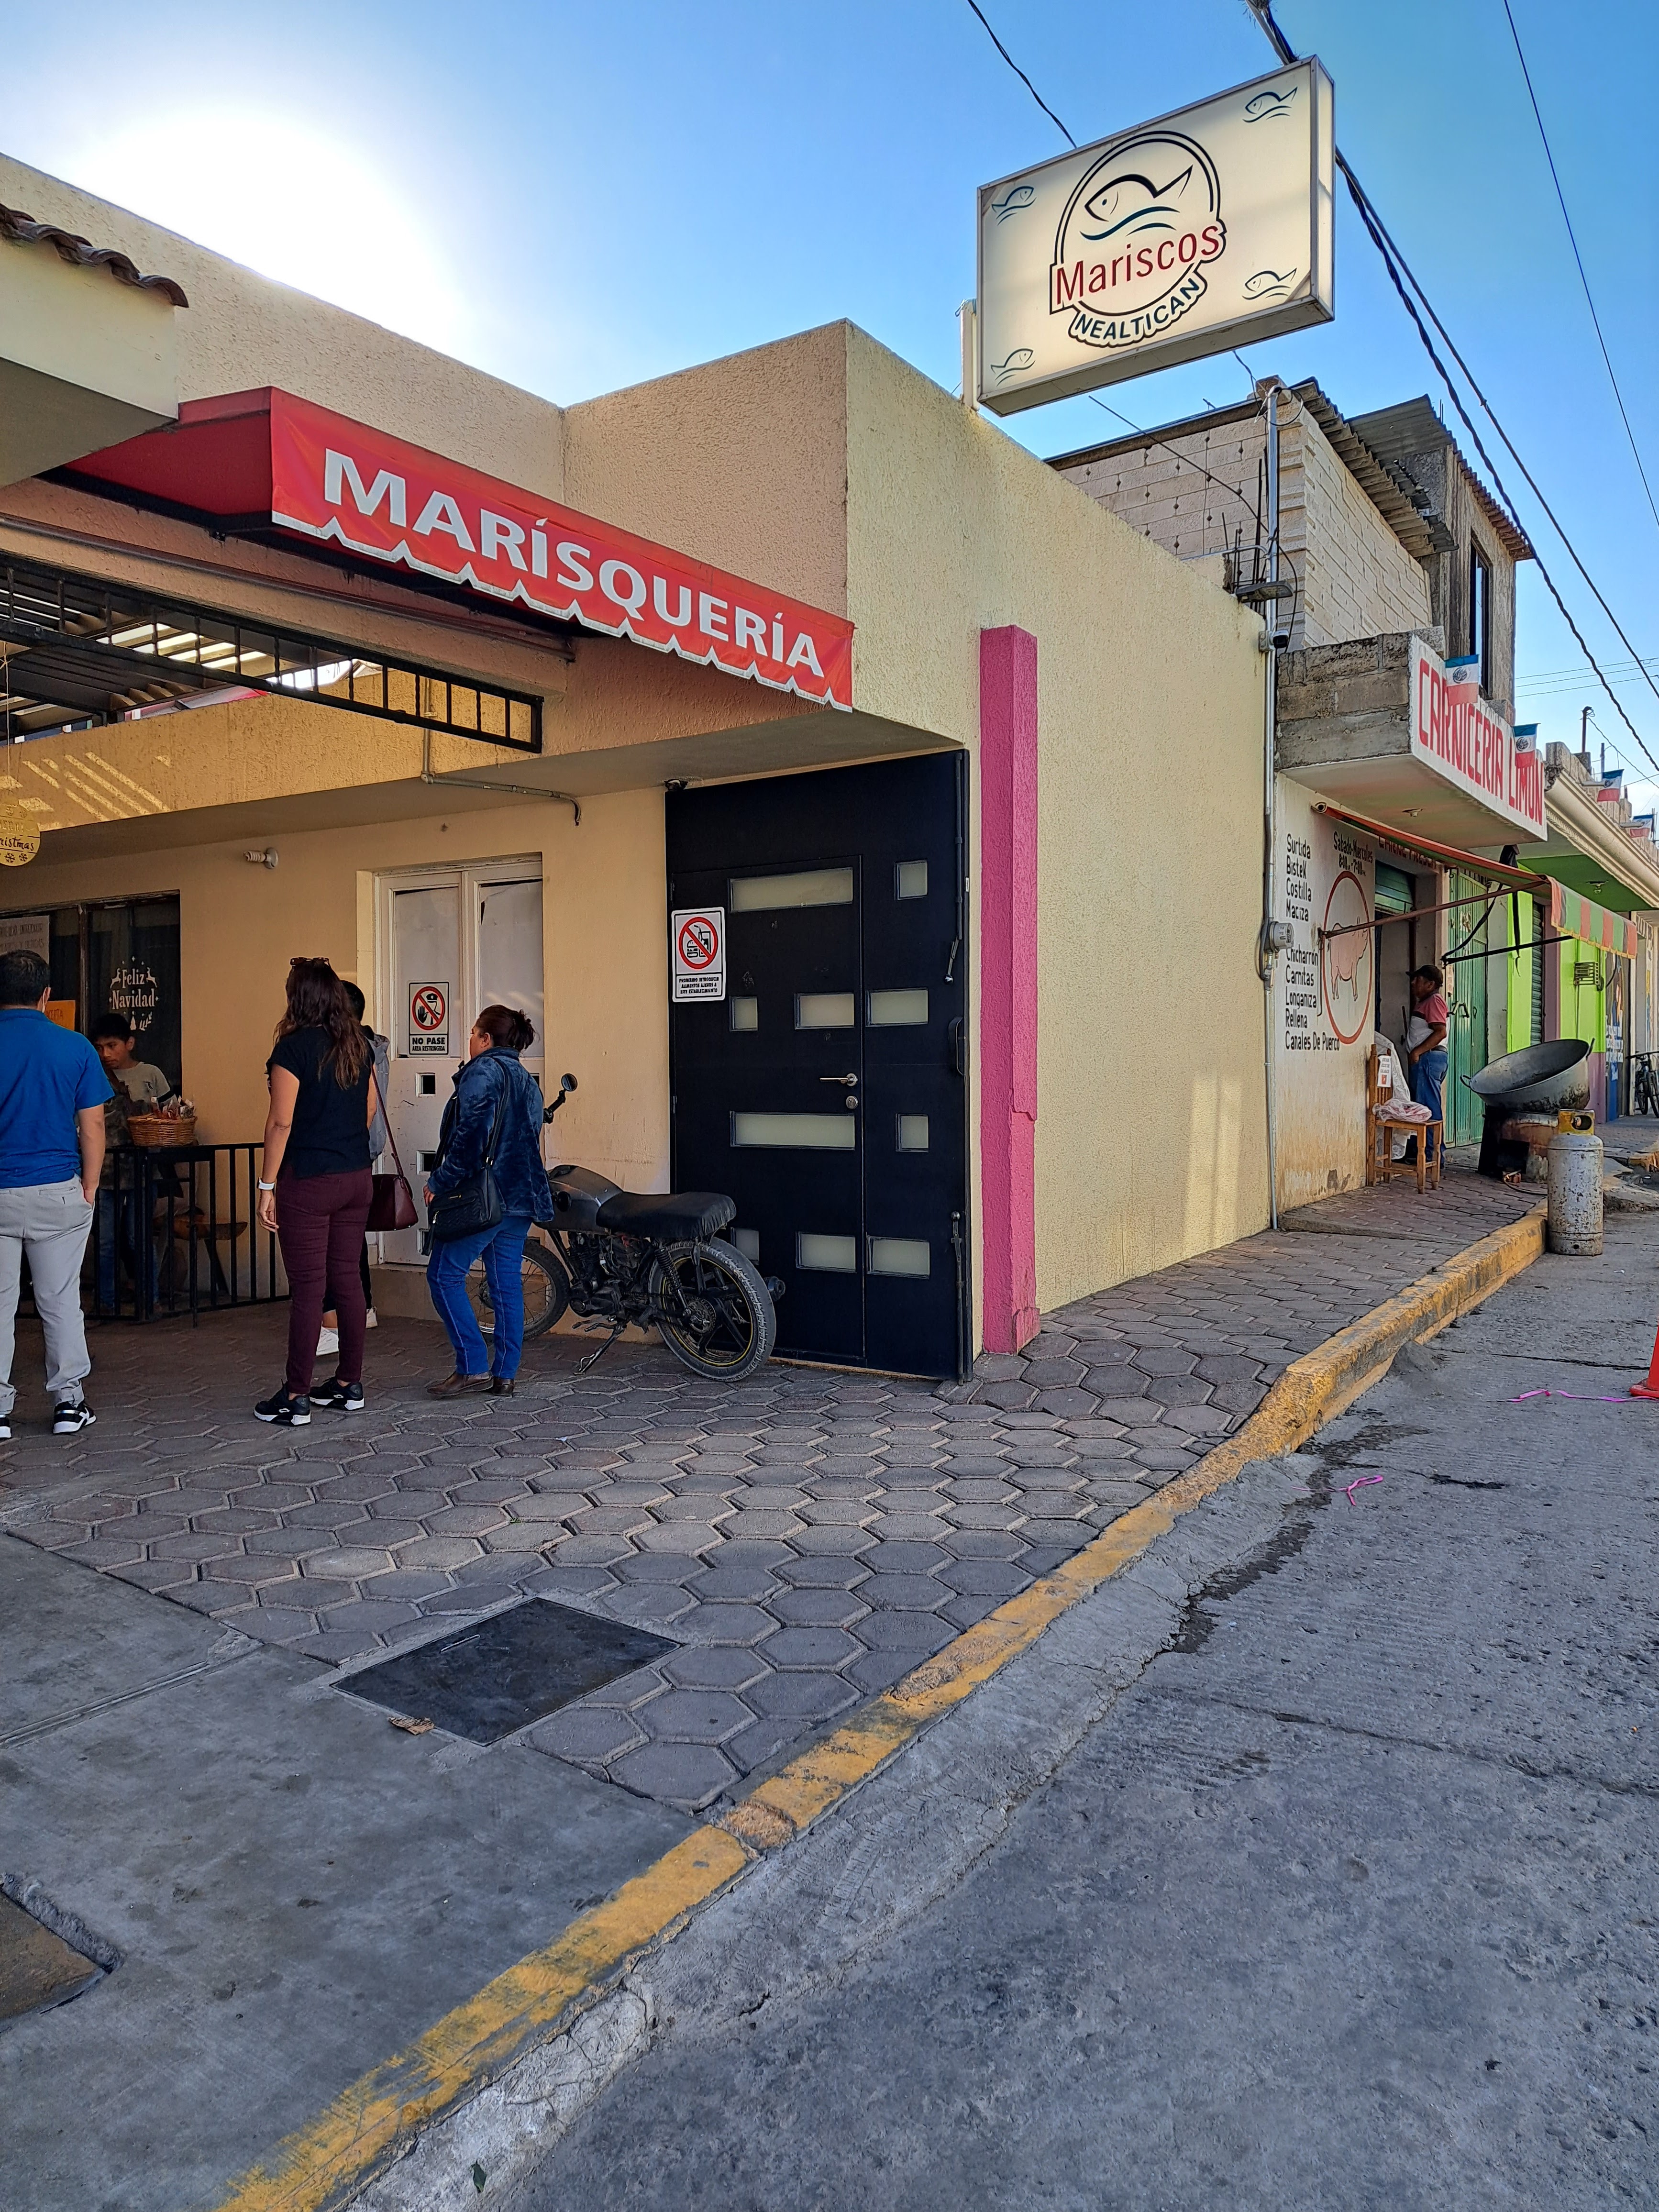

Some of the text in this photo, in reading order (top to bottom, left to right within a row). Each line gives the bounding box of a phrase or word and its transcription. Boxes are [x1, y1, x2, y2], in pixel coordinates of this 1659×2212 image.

[1055, 225, 1220, 305] Mariscos
[1074, 277, 1201, 341] NEALTICAN
[324, 448, 825, 678] MARÍSQUERÍA
[0, 837, 34, 851] ristmas
[1287, 833, 1311, 859] Surtida
[1286, 877, 1312, 902] Costilla
[1286, 898, 1309, 922] Maciza
[122, 968, 145, 989] Feliz
[1285, 964, 1314, 986] Carnitas
[112, 988, 155, 1010] Navidad
[1286, 986, 1317, 1010] Longaniza
[1285, 1008, 1307, 1029] Rellena
[1285, 1030, 1340, 1051] Canales De Puerco
